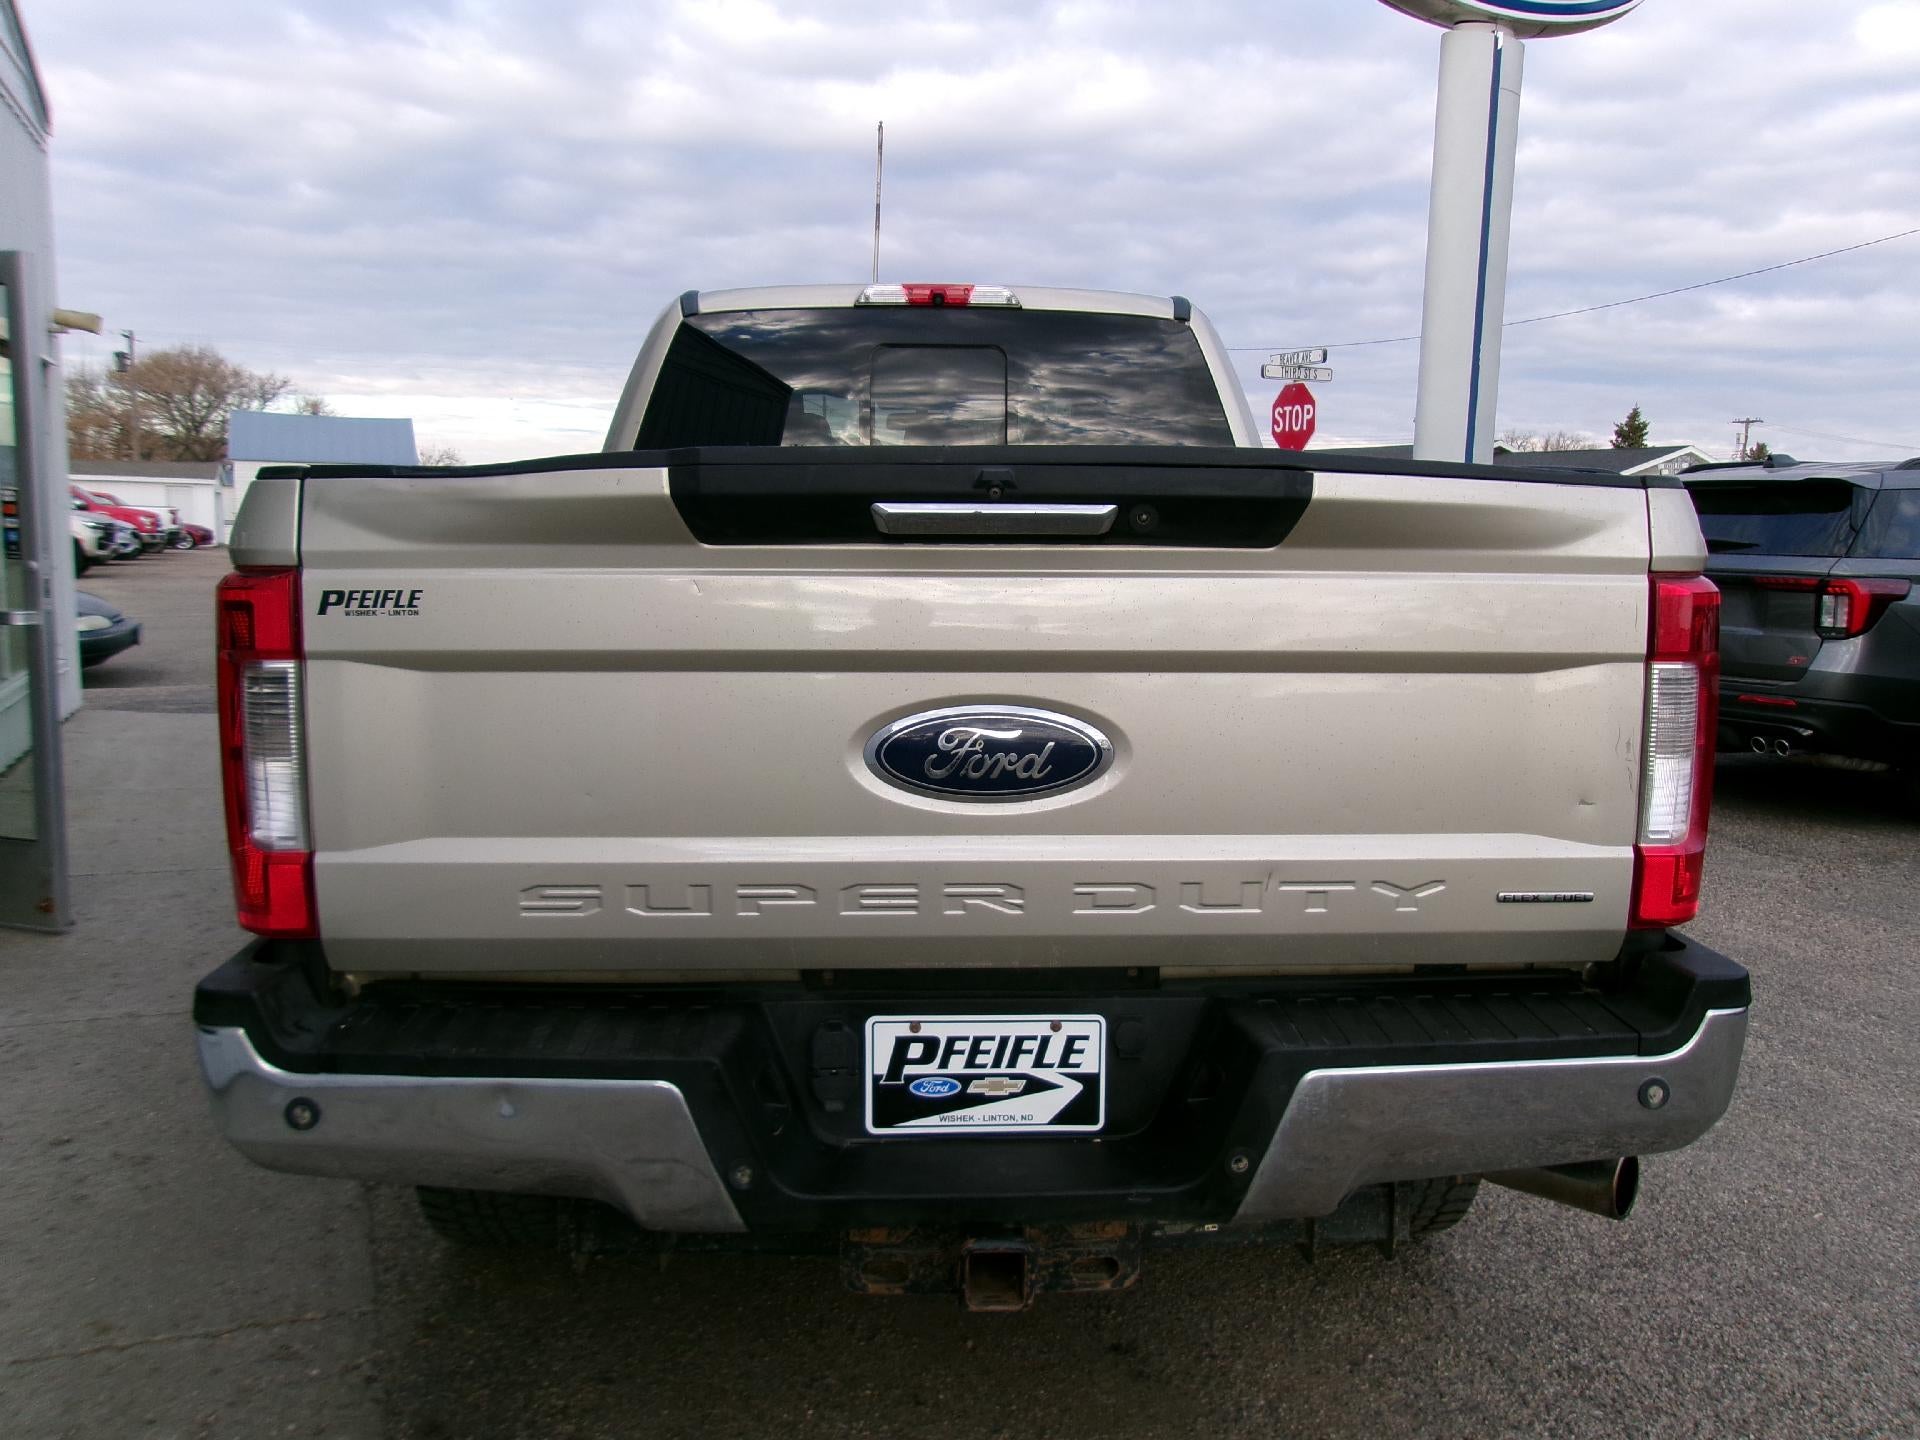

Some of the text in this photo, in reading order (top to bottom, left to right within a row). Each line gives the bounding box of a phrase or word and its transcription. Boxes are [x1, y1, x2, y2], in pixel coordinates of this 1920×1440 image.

[1280, 351, 1312, 365] BEAVER AVE
[1281, 366, 1318, 379] THIRD ST S
[1273, 404, 1314, 433] STOP
[317, 589, 424, 615] PFEIFLE
[924, 727, 1055, 780] Ford
[519, 879, 1447, 917] SUPER DUTY
[1502, 894, 1541, 903] FLEX
[879, 1034, 1091, 1084] PFEIFLE
[919, 1079, 950, 1093] Ford
[938, 1114, 975, 1123] WISHEK
[982, 1114, 1019, 1123] LINTON,
[1020, 1114, 1034, 1122] ND
